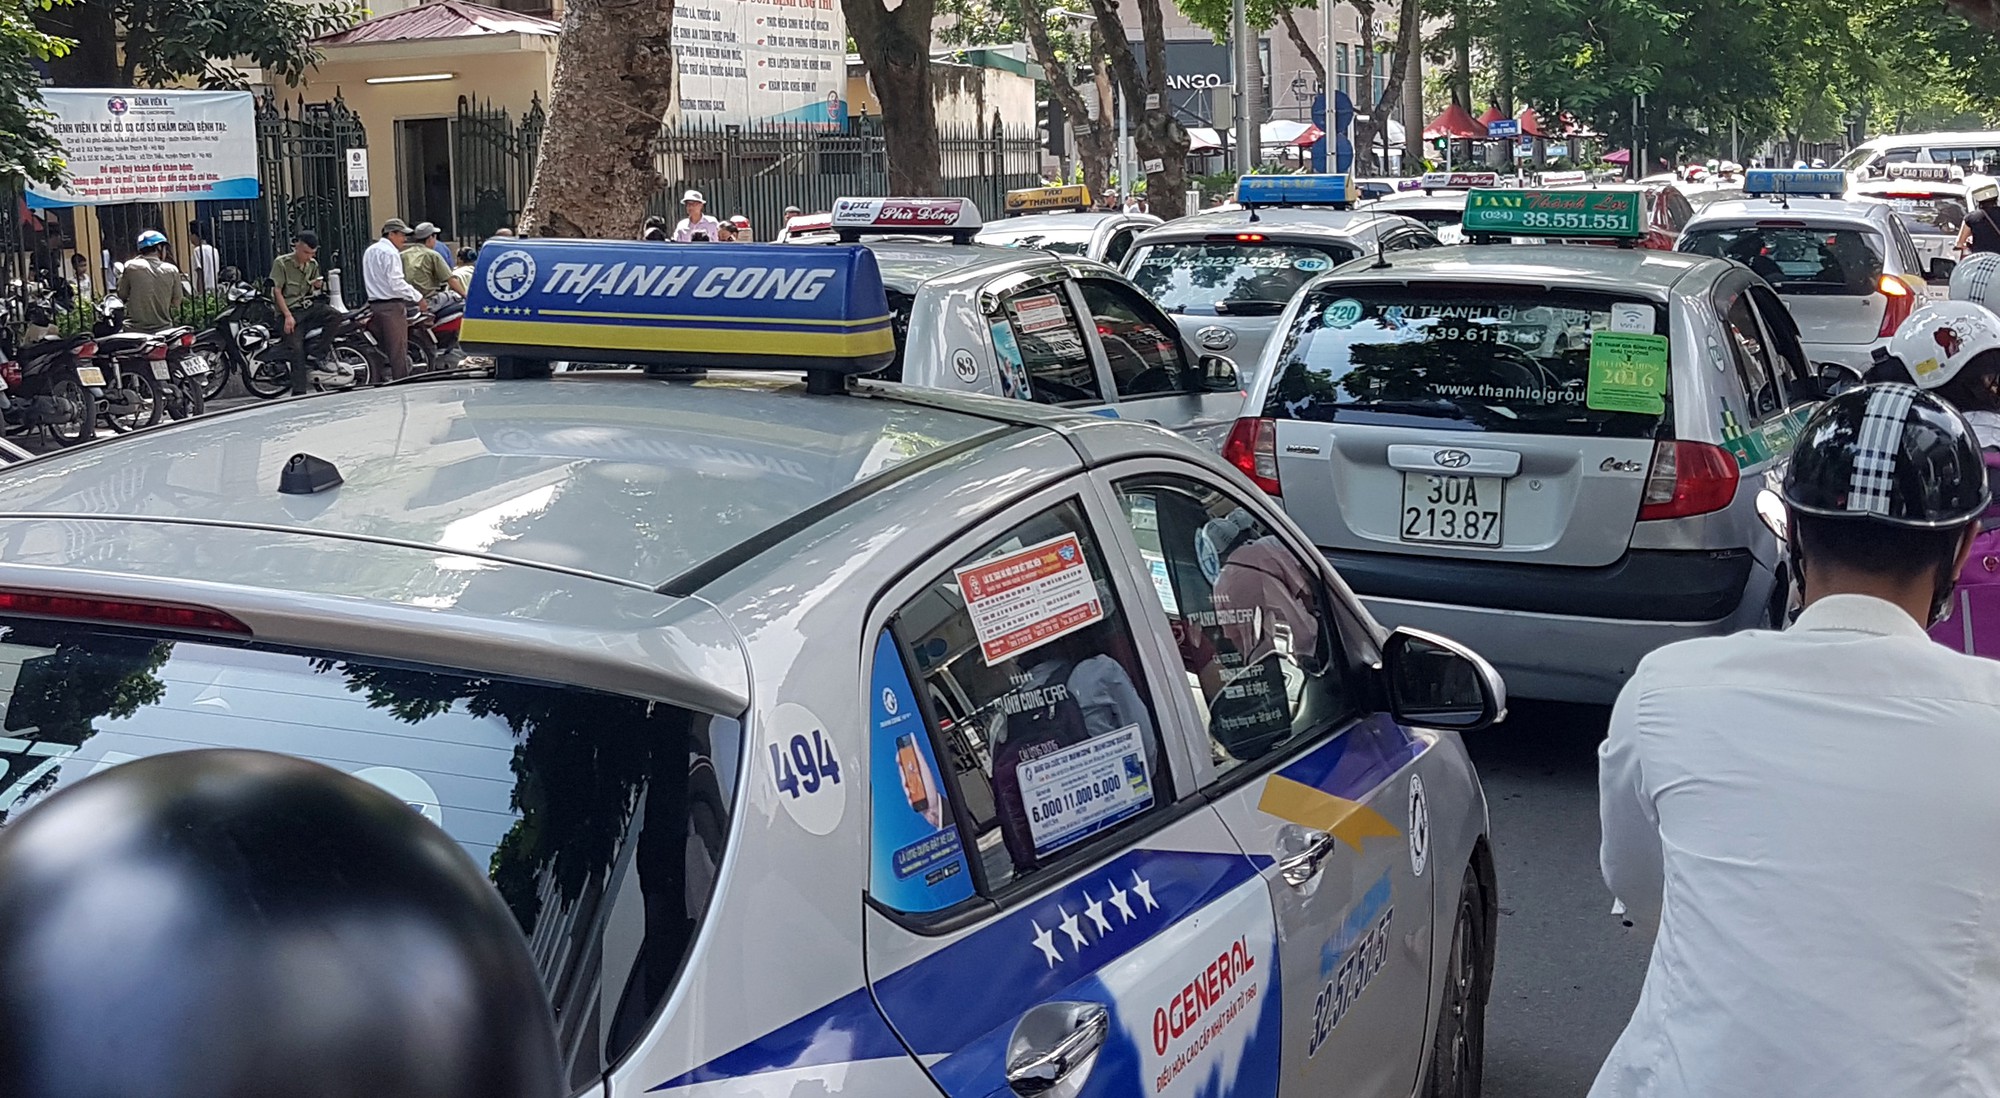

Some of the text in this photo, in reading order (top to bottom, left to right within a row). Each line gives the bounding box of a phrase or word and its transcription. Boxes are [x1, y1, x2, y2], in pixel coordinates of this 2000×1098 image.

[1166, 73, 1221, 89] ANGO
[54, 121, 73, 136] BỆNH
[74, 121, 91, 136] VIỆN
[93, 123, 98, 133] K
[100, 119, 112, 132] CHỈ
[114, 120, 123, 133] CÓ
[157, 120, 177, 132] KHÁM
[196, 121, 214, 135] BỆNH
[1475, 196, 1522, 208] TAXI
[1522, 211, 1629, 230] 38.551.551
[1297, 260, 1323, 269] 367
[694, 267, 836, 301] CONG
[1332, 305, 1356, 321] 720
[1376, 305, 1415, 318] TAXI
[1420, 306, 1481, 319] THANH
[956, 356, 976, 377] 83
[1602, 369, 1654, 388] 2016
[1427, 476, 1478, 508] 30A
[1405, 507, 1499, 541] 213.87
[1043, 684, 1070, 705] CAR
[769, 729, 840, 799] 494
[1031, 774, 1121, 823] 6.000 11.000 9.000
[1156, 1064, 1172, 1093] ĐIỀU
[1186, 1041, 1199, 1064] CAO
[1199, 1030, 1210, 1051] CẤP
